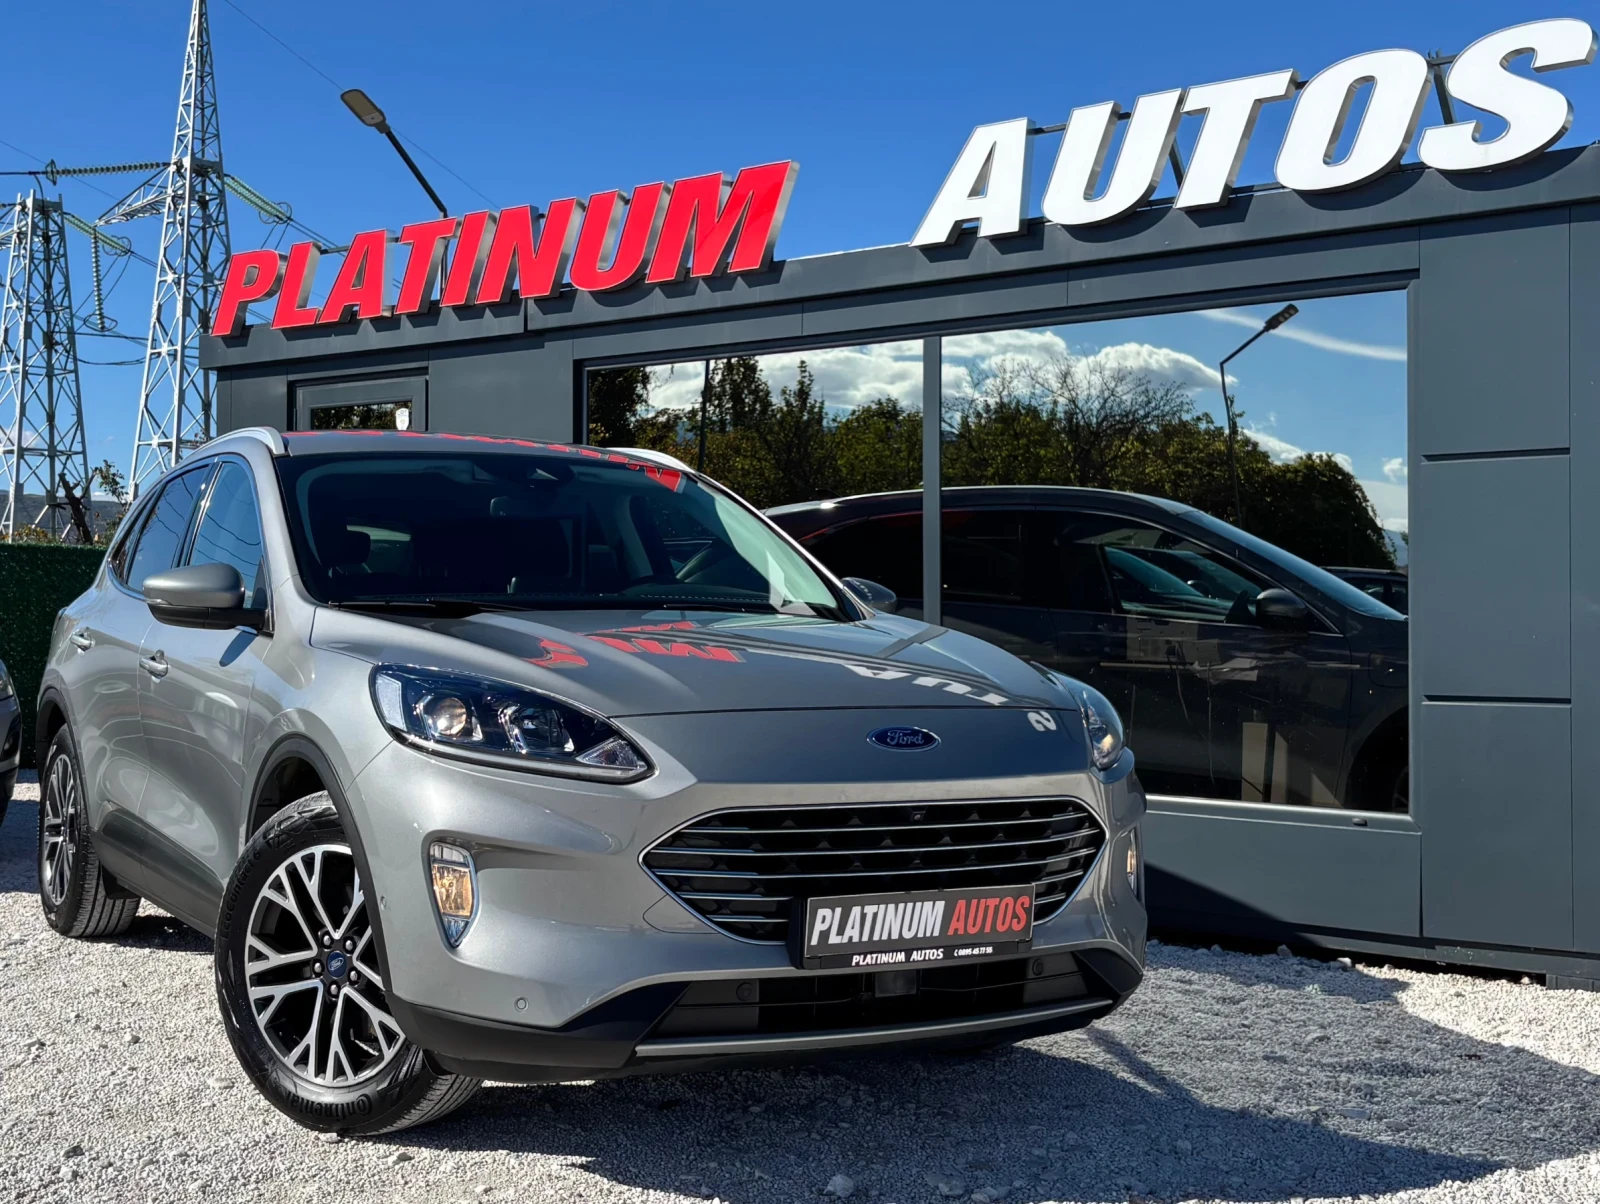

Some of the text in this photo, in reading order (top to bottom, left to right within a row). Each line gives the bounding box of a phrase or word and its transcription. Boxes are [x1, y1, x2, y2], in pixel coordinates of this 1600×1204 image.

[211, 17, 1597, 337] PLATINUM AUTOS
[887, 729, 924, 745] Ford
[810, 895, 1030, 946] PLATINUM AUTOS
[852, 950, 905, 967] PLATINUM
[910, 949, 944, 962] AUTOS
